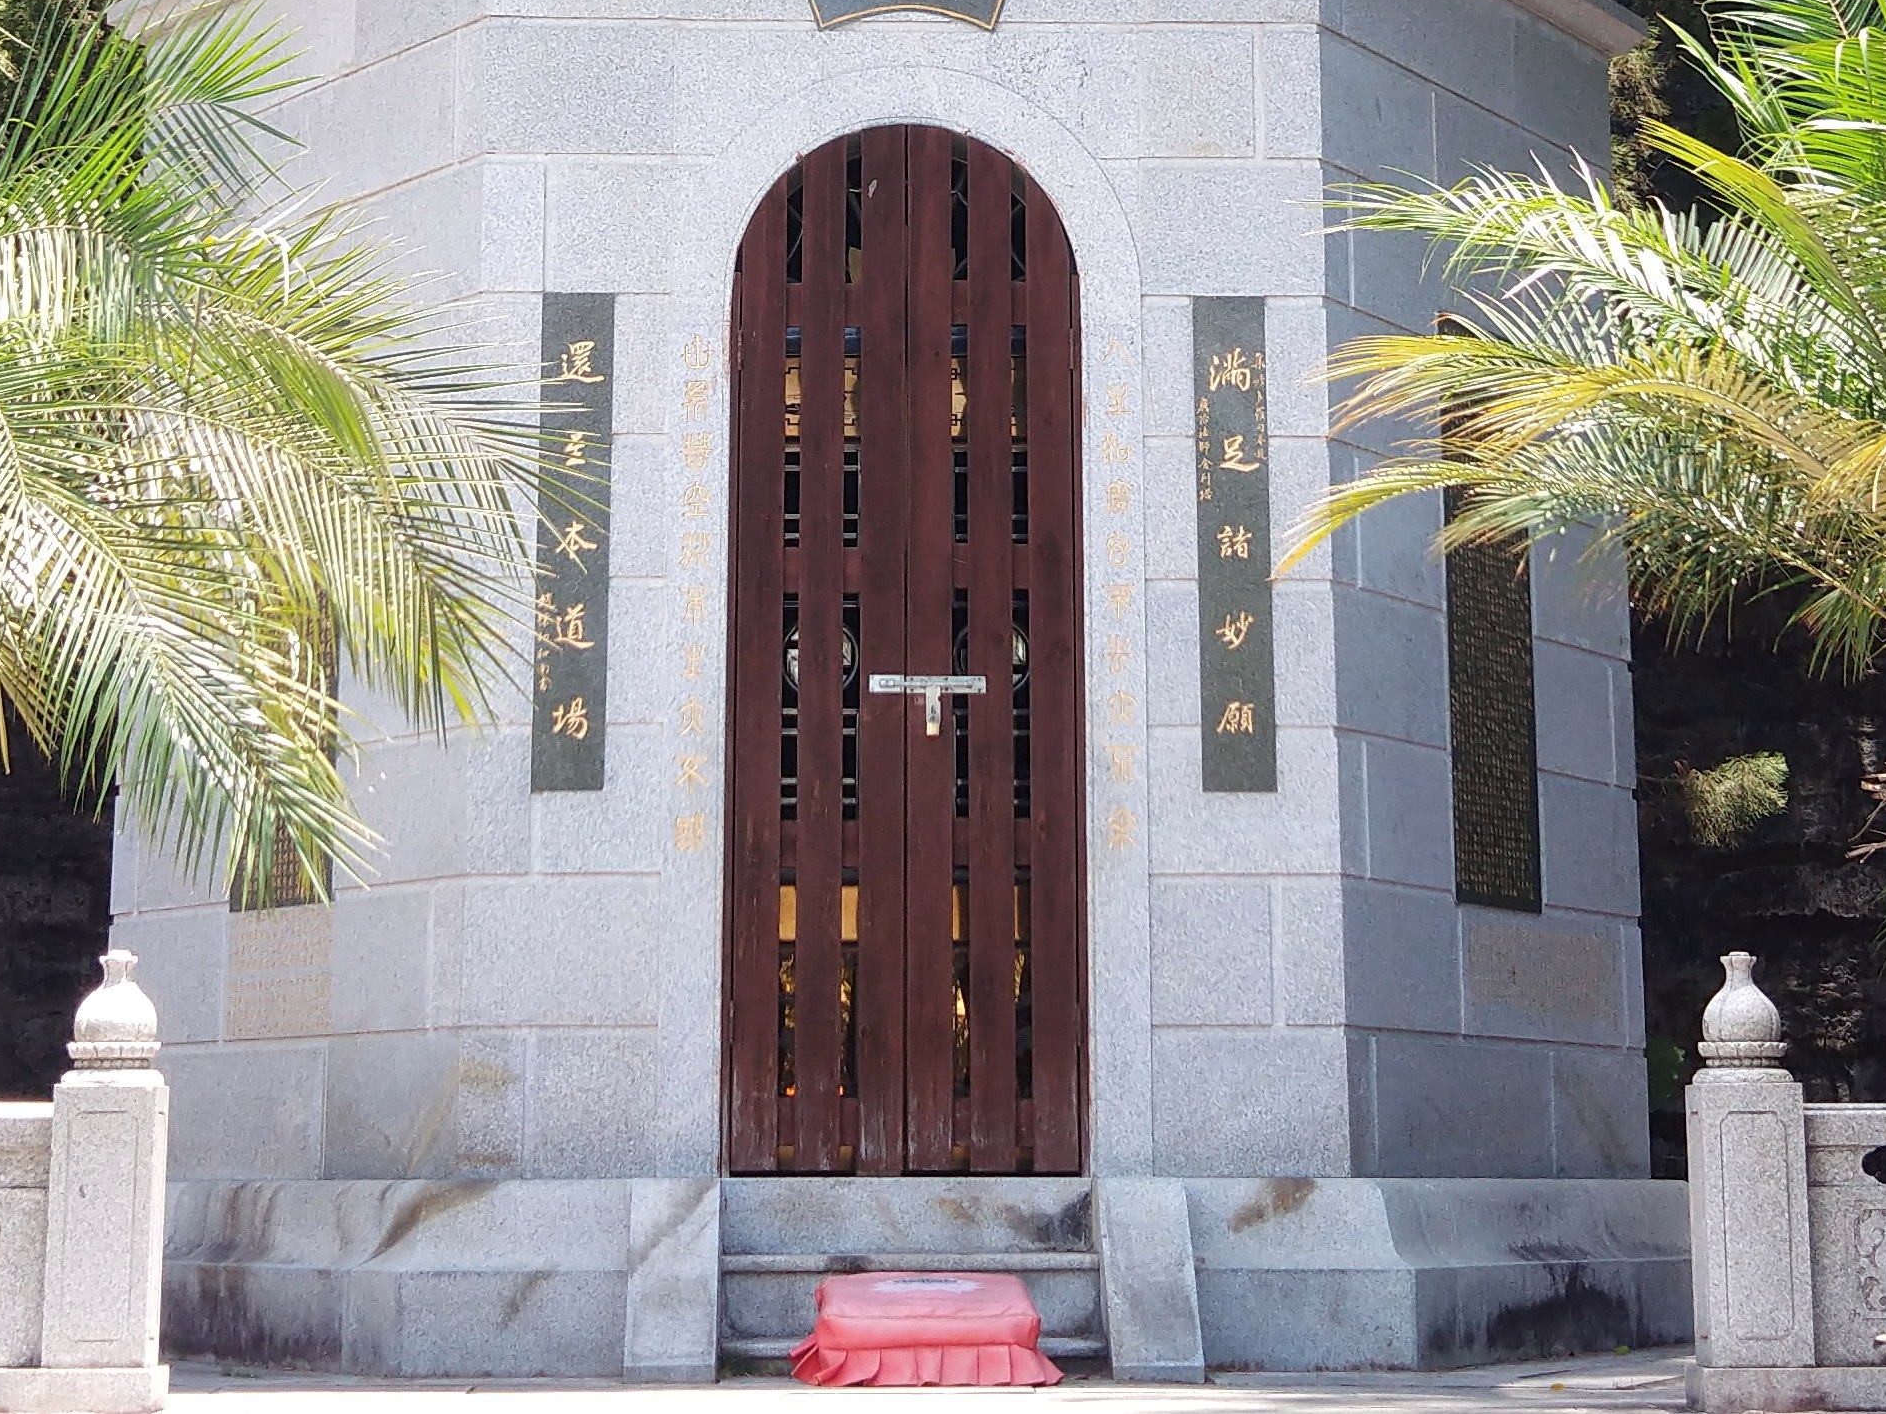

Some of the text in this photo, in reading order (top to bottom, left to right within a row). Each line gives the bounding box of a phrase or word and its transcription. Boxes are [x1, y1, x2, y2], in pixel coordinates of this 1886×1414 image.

[1209, 346, 1261, 735] 滿足諸妙願
